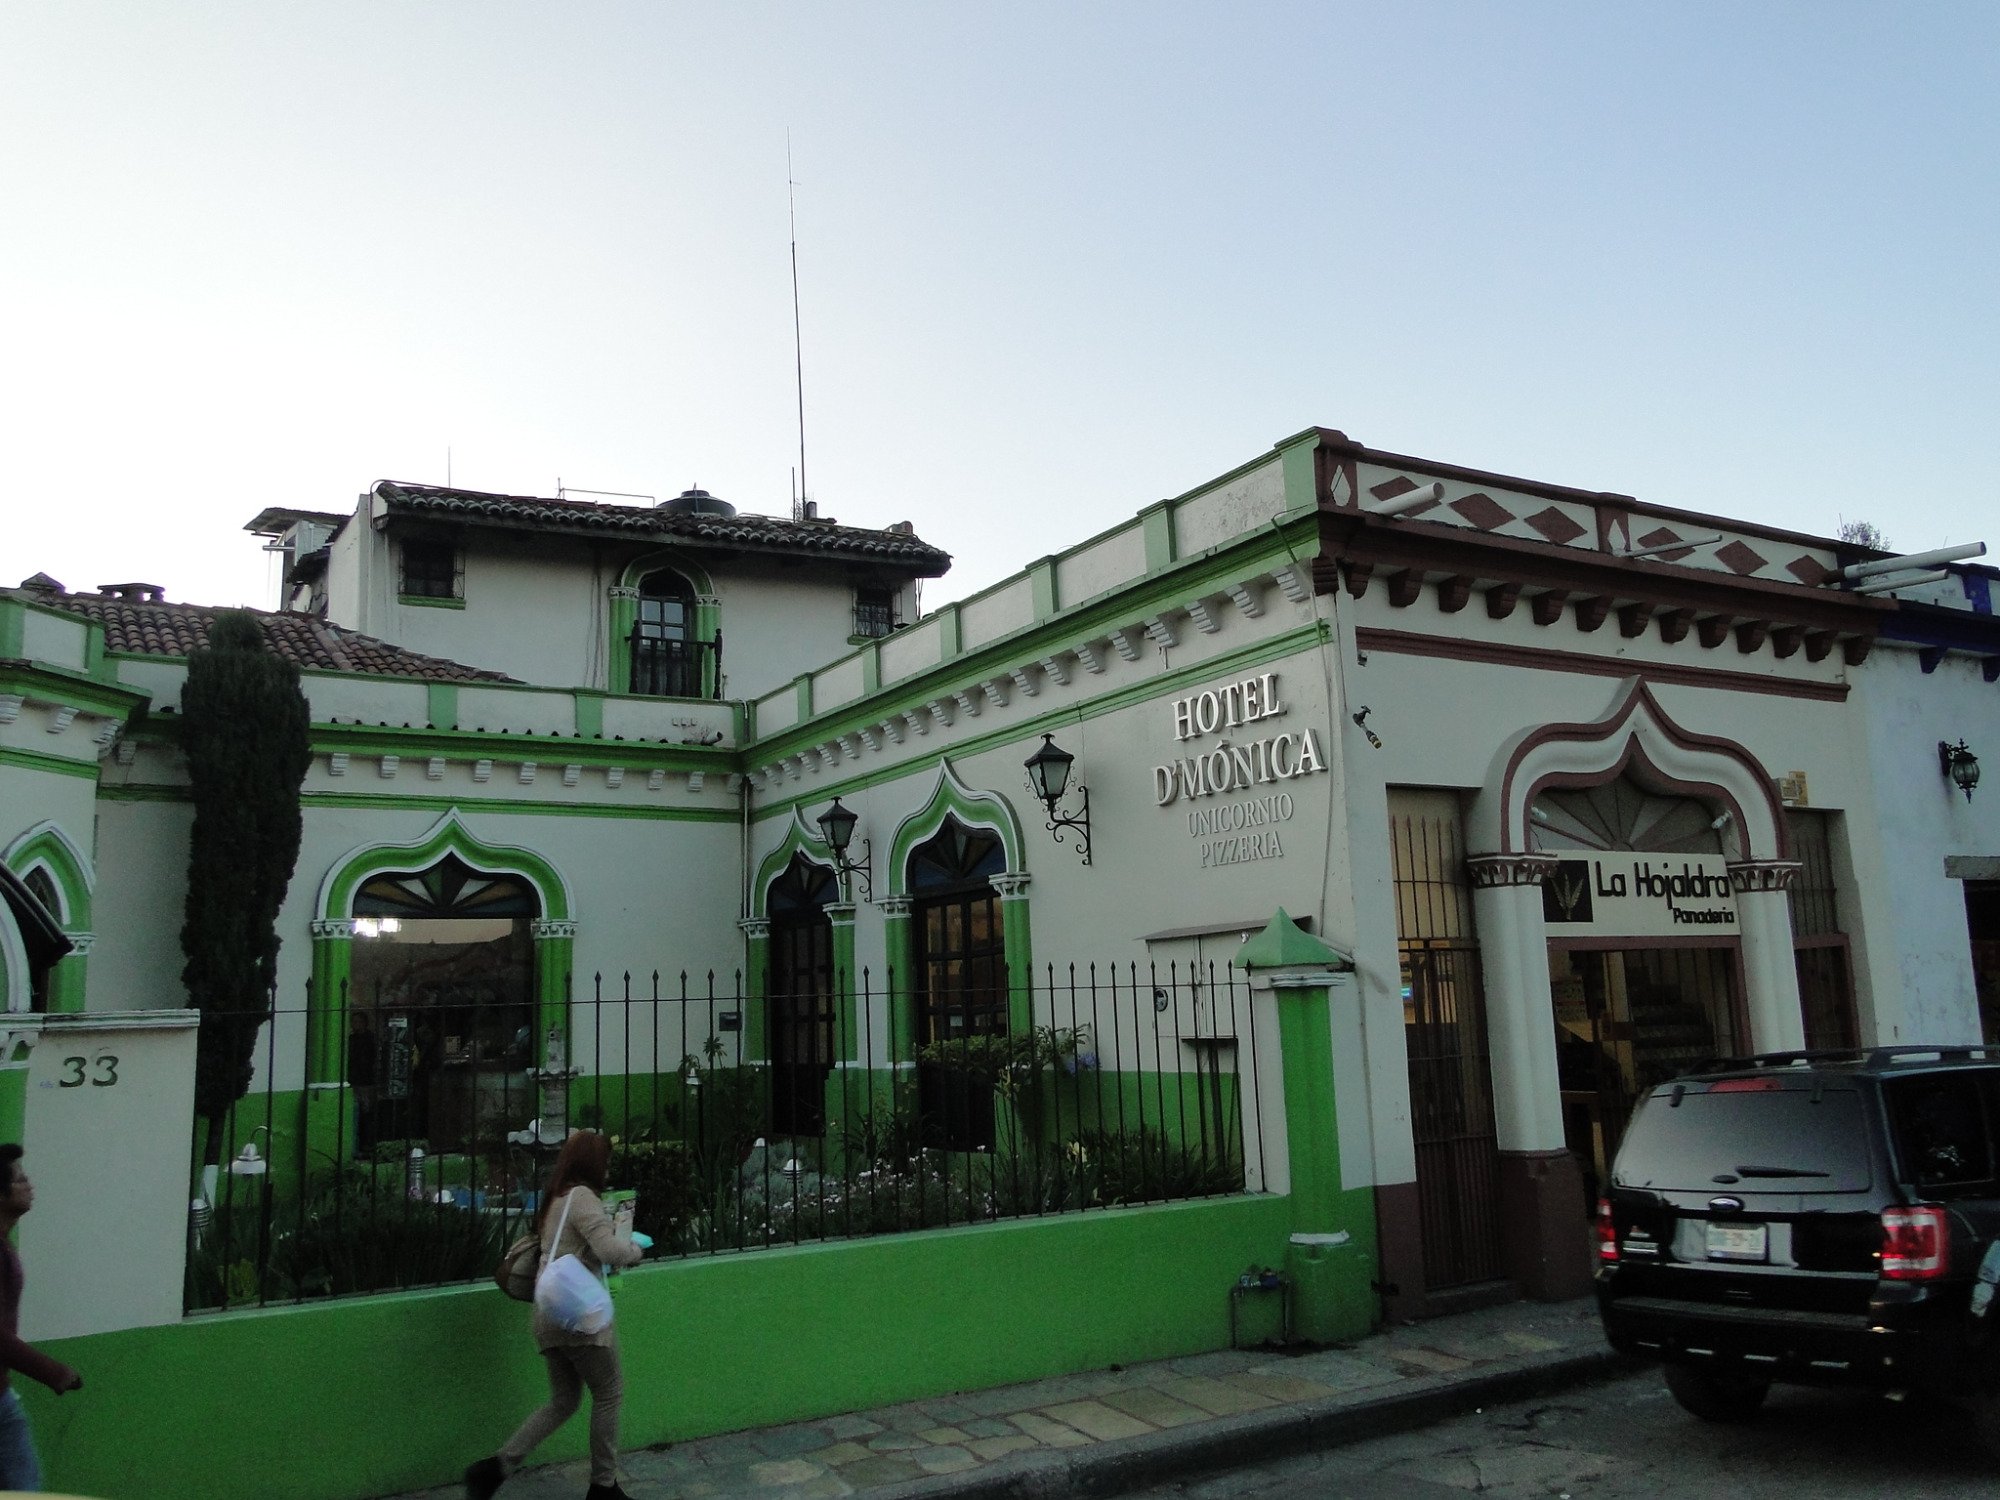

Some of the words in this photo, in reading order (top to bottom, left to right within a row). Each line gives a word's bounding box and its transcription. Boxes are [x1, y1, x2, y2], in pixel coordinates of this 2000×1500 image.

[1171, 673, 1284, 741] HOTEL
[1187, 793, 1294, 838] UNICORNIO
[1201, 831, 1284, 868] PIZZERIA
[1595, 860, 1627, 897] La
[1633, 861, 1731, 910] Hojaldra
[59, 1055, 119, 1088] 33
